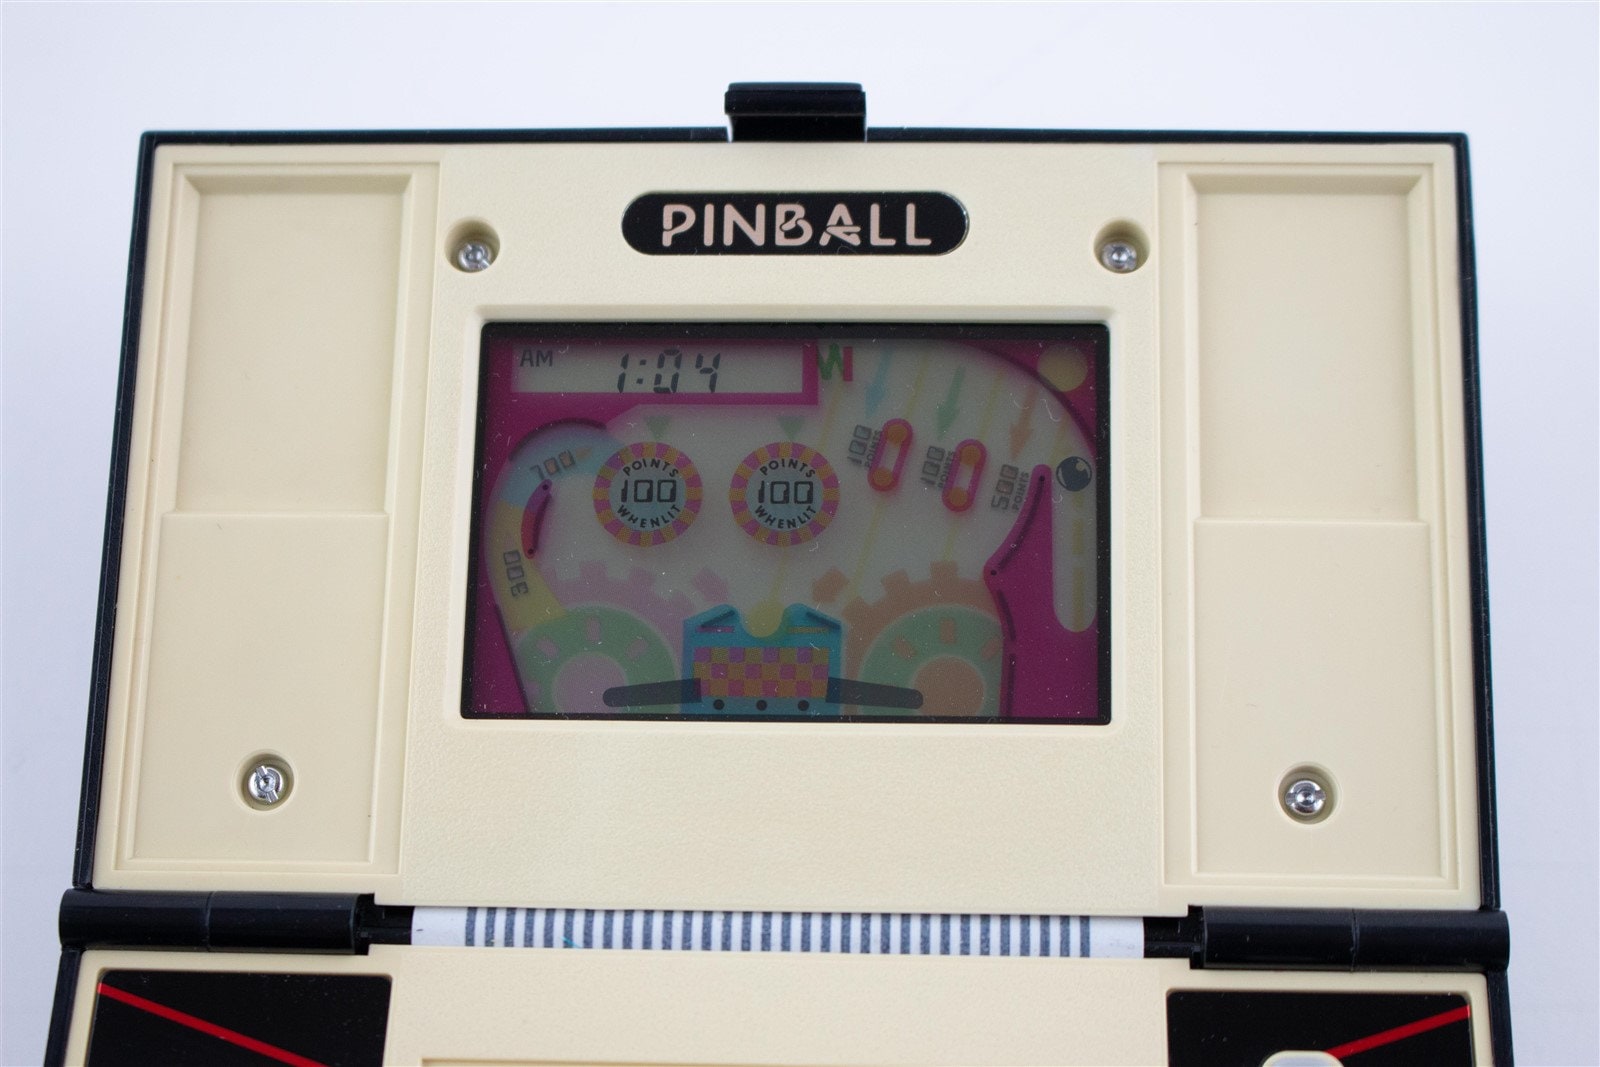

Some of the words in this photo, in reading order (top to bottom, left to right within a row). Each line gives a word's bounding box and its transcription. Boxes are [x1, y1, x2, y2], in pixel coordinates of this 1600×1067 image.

[662, 203, 932, 246] PINBALL
[519, 350, 553, 367] AM
[617, 349, 721, 394] 1:04
[622, 458, 680, 477] POINTS
[760, 458, 816, 478] POINTS
[621, 479, 677, 503] 100
[758, 480, 814, 504] 100
[1012, 472, 1029, 511] POINTS
